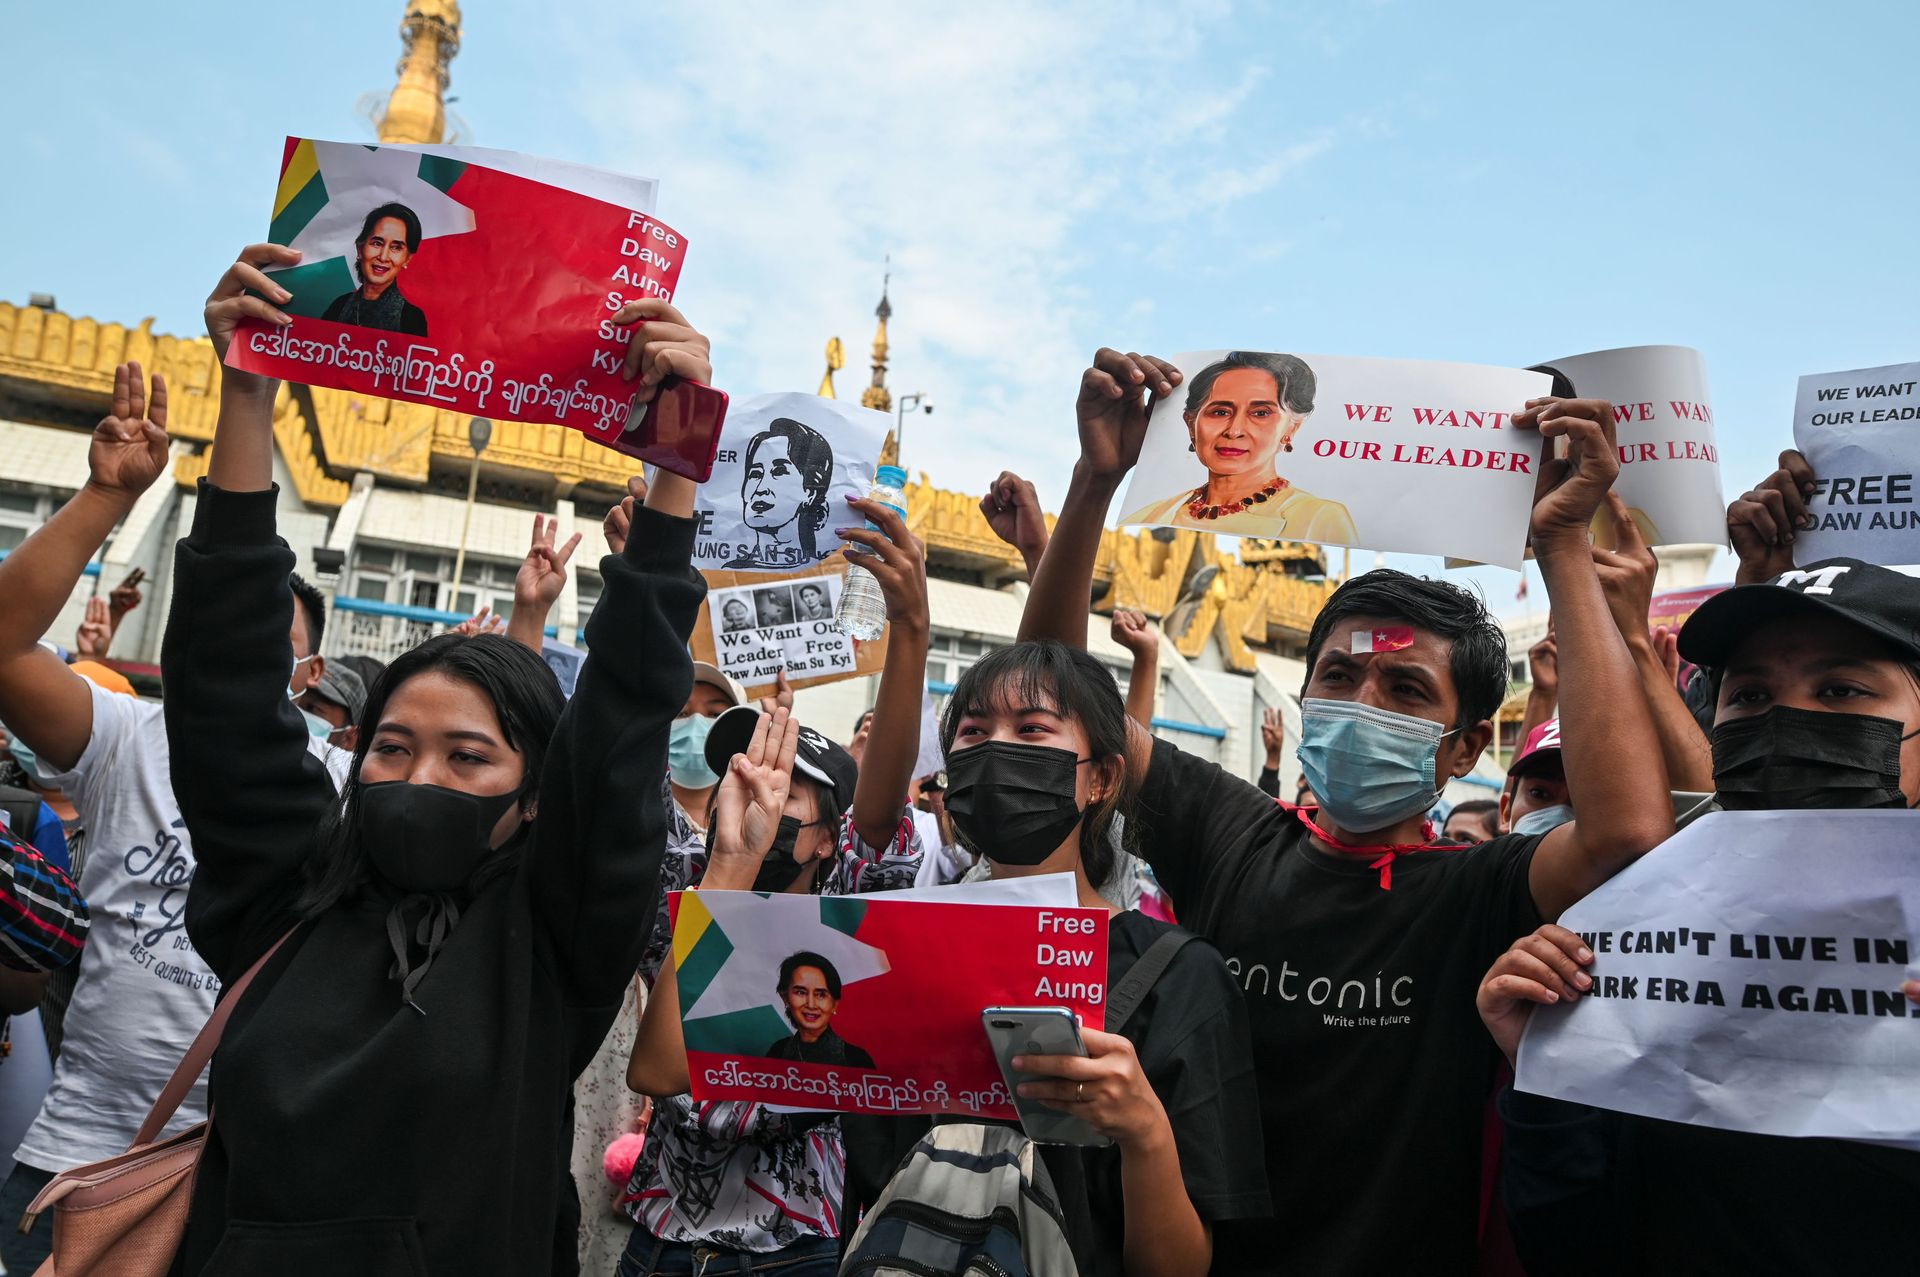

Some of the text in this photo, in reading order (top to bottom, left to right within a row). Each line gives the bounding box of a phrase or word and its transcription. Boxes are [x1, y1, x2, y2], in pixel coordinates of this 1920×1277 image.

[627, 211, 678, 249] Free
[620, 237, 672, 272] Daw
[598, 320, 631, 344] Su
[591, 349, 625, 375] Ky
[1817, 381, 1918, 402] WE WANT
[1343, 403, 1509, 430] WE WANT
[1611, 402, 1655, 424] WE
[1811, 406, 1920, 426] OUR LEAD
[1313, 439, 1531, 474] OUR LEADER
[1617, 442, 1659, 464] UR
[1804, 474, 1913, 505] FREE
[1800, 511, 1863, 532] DAW
[736, 543, 778, 563] SAN
[720, 621, 840, 648] We Want Ou
[723, 640, 843, 666] Leader Free
[786, 660, 807, 672] San
[810, 657, 825, 669] Su
[830, 652, 851, 668] Kyi
[1038, 911, 1096, 935] Free
[1037, 943, 1094, 967] Daw
[1619, 927, 1716, 956] CAN'T
[1730, 933, 1837, 962] LIVE
[1853, 937, 1909, 965] IN
[129, 942, 157, 969] BEST
[154, 961, 204, 990] QUALITY
[1034, 976, 1103, 1005] Aung
[1582, 975, 1920, 1019] ARK ERA AGAIN
[1323, 1013, 1411, 1027] Write the future
